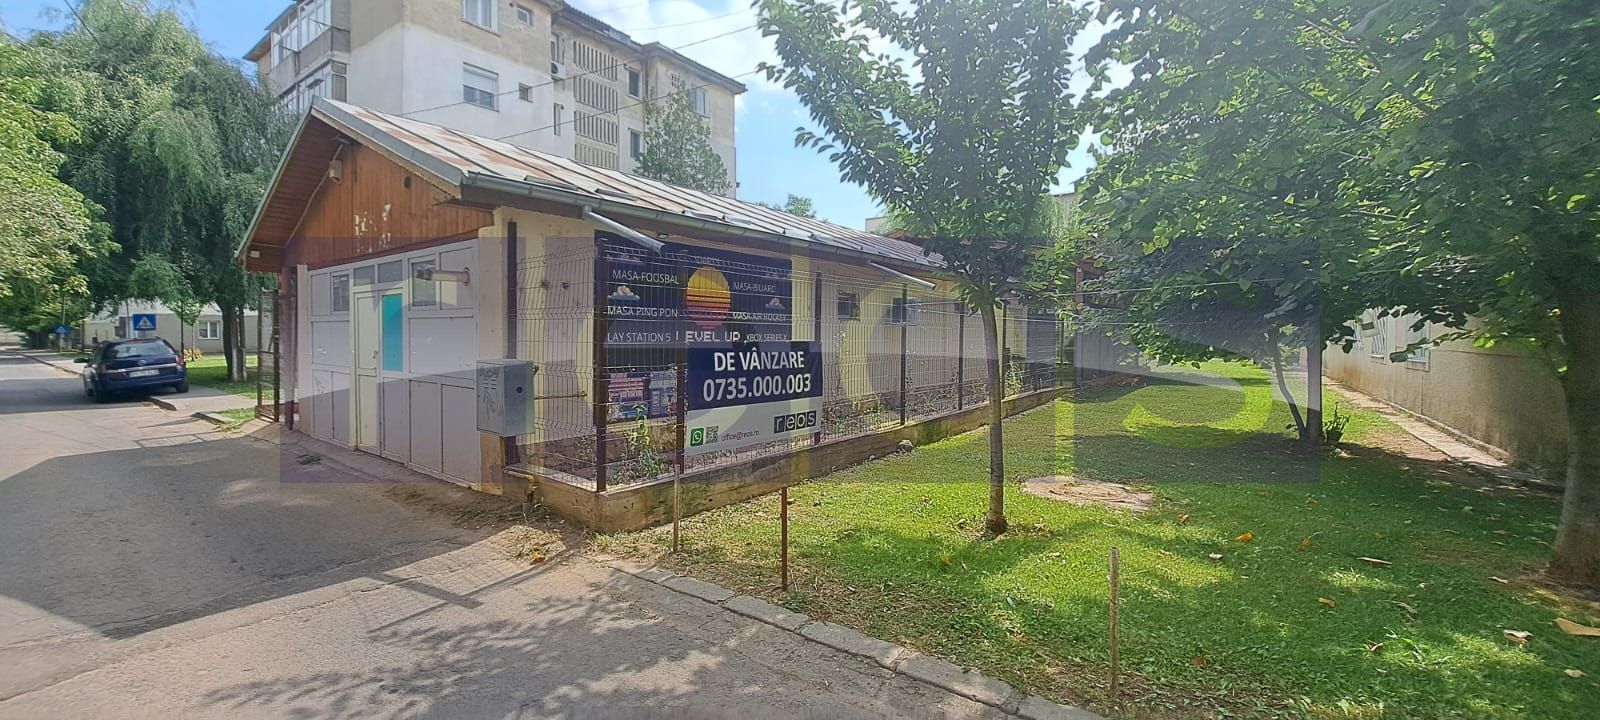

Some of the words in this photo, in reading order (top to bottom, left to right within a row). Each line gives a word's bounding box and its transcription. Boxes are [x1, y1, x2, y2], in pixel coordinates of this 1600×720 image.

[607, 305, 634, 316] MASA
[636, 307, 658, 317] PING
[659, 308, 679, 318] PON
[607, 332, 624, 342] LAY
[626, 332, 664, 342] STATION
[725, 331, 741, 342] UP
[714, 352, 735, 371] DE
[739, 347, 805, 370] VÂNZARE
[703, 373, 811, 402] 0735.000.003
[775, 411, 816, 433] reos
[721, 430, 760, 442] office@reos.ro
